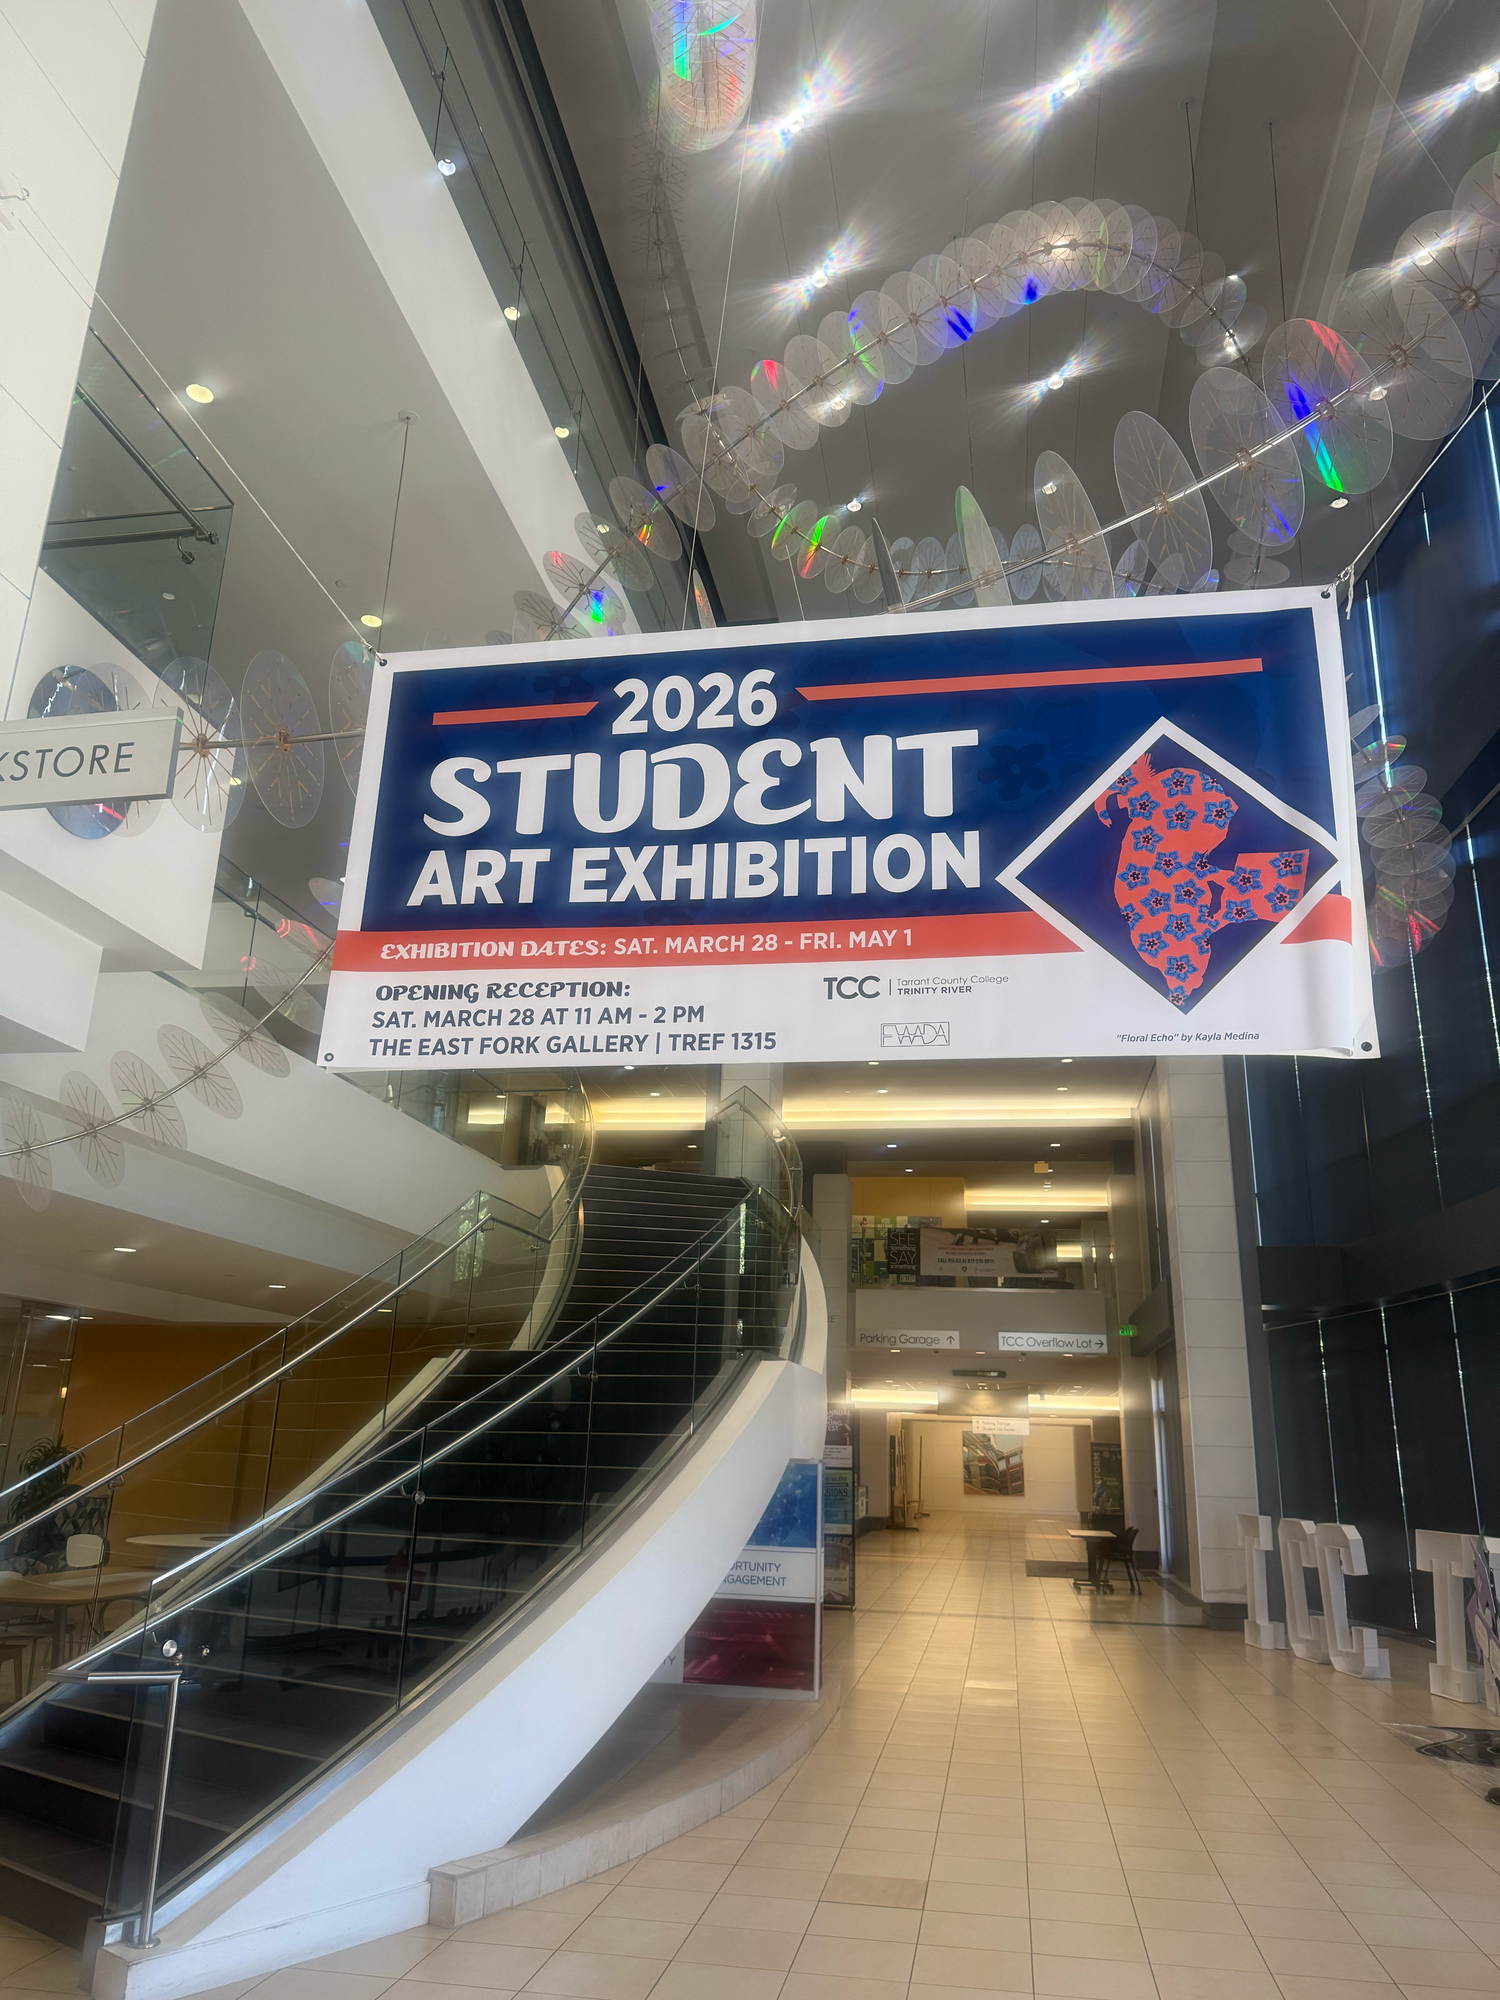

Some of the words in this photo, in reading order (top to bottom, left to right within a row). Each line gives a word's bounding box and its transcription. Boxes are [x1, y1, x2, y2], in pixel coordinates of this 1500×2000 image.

[611, 668, 778, 735] 2026
[423, 729, 979, 836] STUDENT
[406, 848, 550, 906] ART
[568, 830, 981, 903] EXHIBITION
[380, 941, 515, 960] EXHIBITION
[520, 939, 607, 957] DATES:
[613, 937, 658, 955] SAT.
[665, 935, 745, 954] MARCH
[751, 934, 778, 952] 28
[799, 931, 842, 950] FRI.
[849, 930, 897, 948] MAY
[903, 928, 913, 946] 1
[375, 983, 480, 1003] OPENING
[486, 981, 631, 999] RECEPTION:
[823, 975, 881, 1000] TCC
[897, 978, 930, 986] Tarrant
[932, 976, 968, 987] County
[970, 975, 1009, 985] College
[897, 986, 938, 996] TRINITY
[941, 985, 972, 994] RIVER
[371, 1011, 417, 1029] SAT.
[423, 1009, 502, 1028] MARCH
[508, 1008, 535, 1026] 28
[540, 1007, 569, 1026] AT
[574, 1007, 592, 1025] 11
[597, 1006, 633, 1025] AM
[653, 1006, 666, 1024] 2
[672, 1005, 705, 1023] PM
[369, 1038, 412, 1056] THE
[418, 1037, 474, 1056] EAST
[479, 1036, 541, 1055] FORK
[546, 1034, 649, 1054] GALLERY
[668, 1032, 726, 1052] TREF
[731, 1031, 777, 1051] 1315
[1116, 1034, 1149, 1043] "Floral
[1150, 1033, 1180, 1042] Echo"
[1181, 1033, 1193, 1043] by
[1195, 1032, 1222, 1043] Kayla
[1223, 1031, 1260, 1041] Medina
[889, 1232, 916, 1247] SEE
[889, 1250, 918, 1265] SAY
[860, 1333, 897, 1347] Parking
[898, 1334, 941, 1347] Garage
[1001, 1336, 1024, 1347] TCC
[1026, 1336, 1075, 1349] Overflow
[1076, 1338, 1092, 1349] Lot
